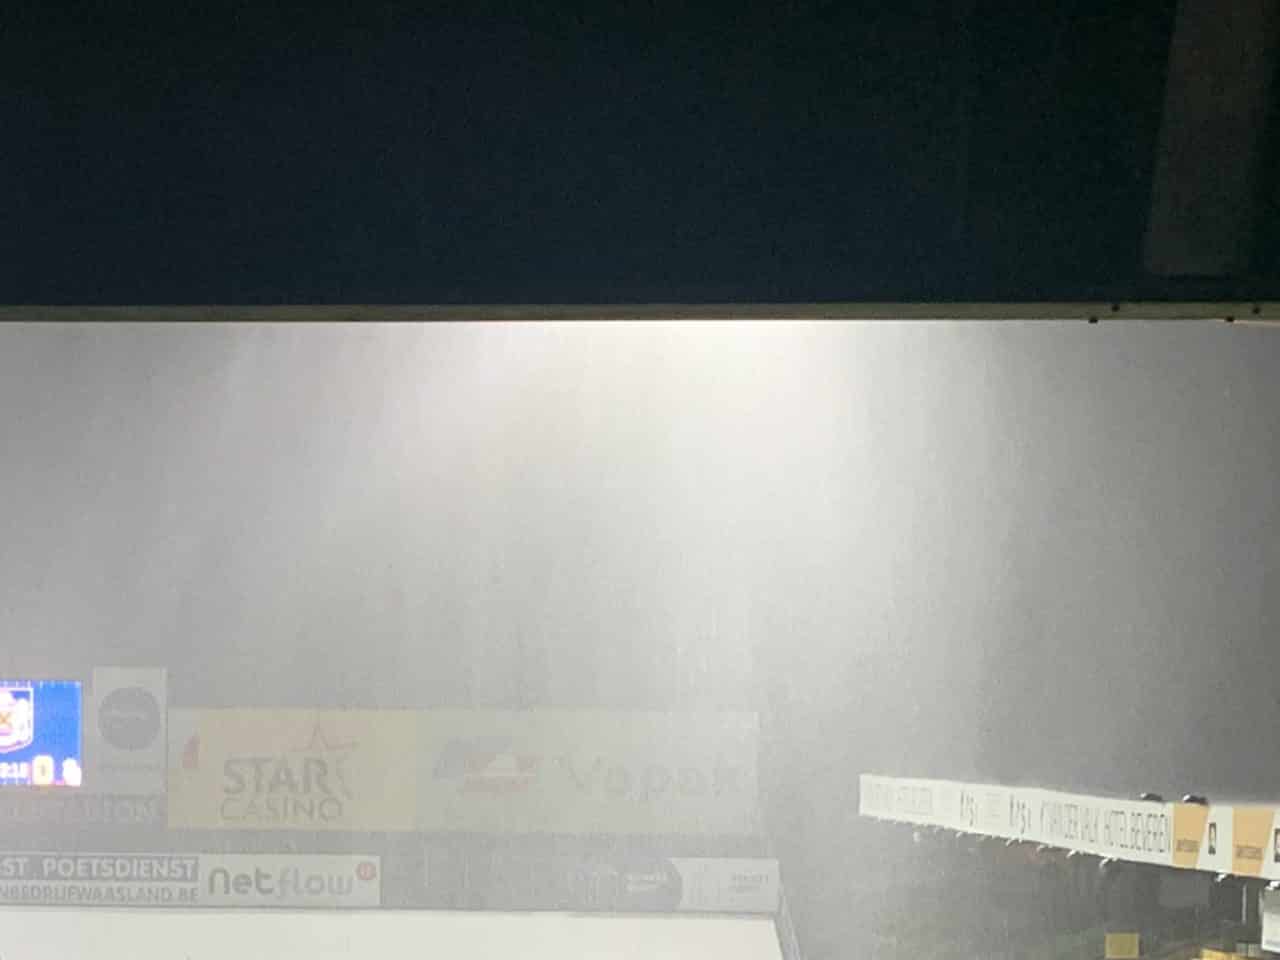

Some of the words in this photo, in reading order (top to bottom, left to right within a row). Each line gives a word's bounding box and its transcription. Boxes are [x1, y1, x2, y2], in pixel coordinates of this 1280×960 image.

[223, 757, 331, 795] STAR
[221, 797, 341, 824] CASINO
[42, 857, 197, 880] POETSDIENST
[208, 864, 353, 898] netflow
